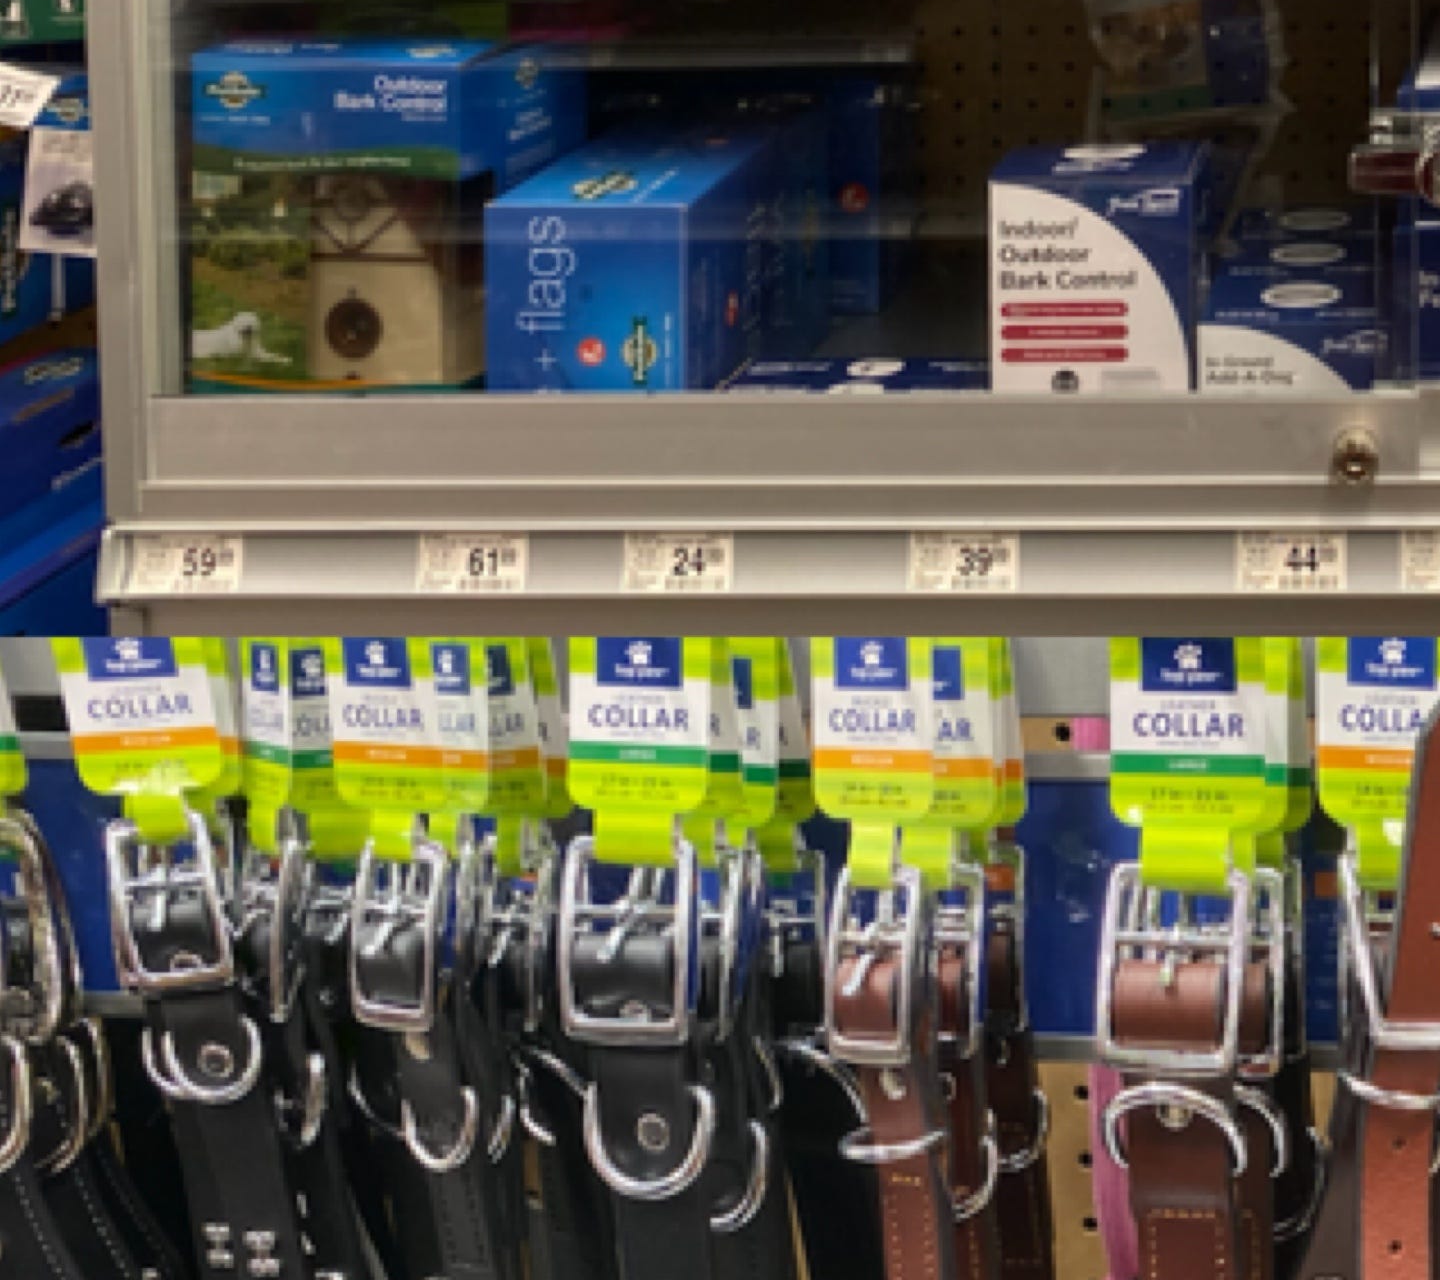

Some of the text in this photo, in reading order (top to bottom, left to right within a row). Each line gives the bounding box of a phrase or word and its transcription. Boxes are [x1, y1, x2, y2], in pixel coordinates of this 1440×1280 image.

[373, 73, 448, 95] Outdoor
[333, 90, 448, 113] Bark Control
[1000, 218, 1079, 240] Indoor/
[1000, 244, 1091, 264] Outdoor
[518, 215, 576, 333] flags
[1000, 270, 1139, 289] Bark Control
[86, 693, 193, 721] COLLAR
[341, 703, 425, 731] COLLAR
[587, 703, 690, 732] COLLAR
[1339, 704, 1424, 733] COLLA
[828, 707, 917, 735] COLLAR
[1132, 712, 1245, 739] COLLAR
